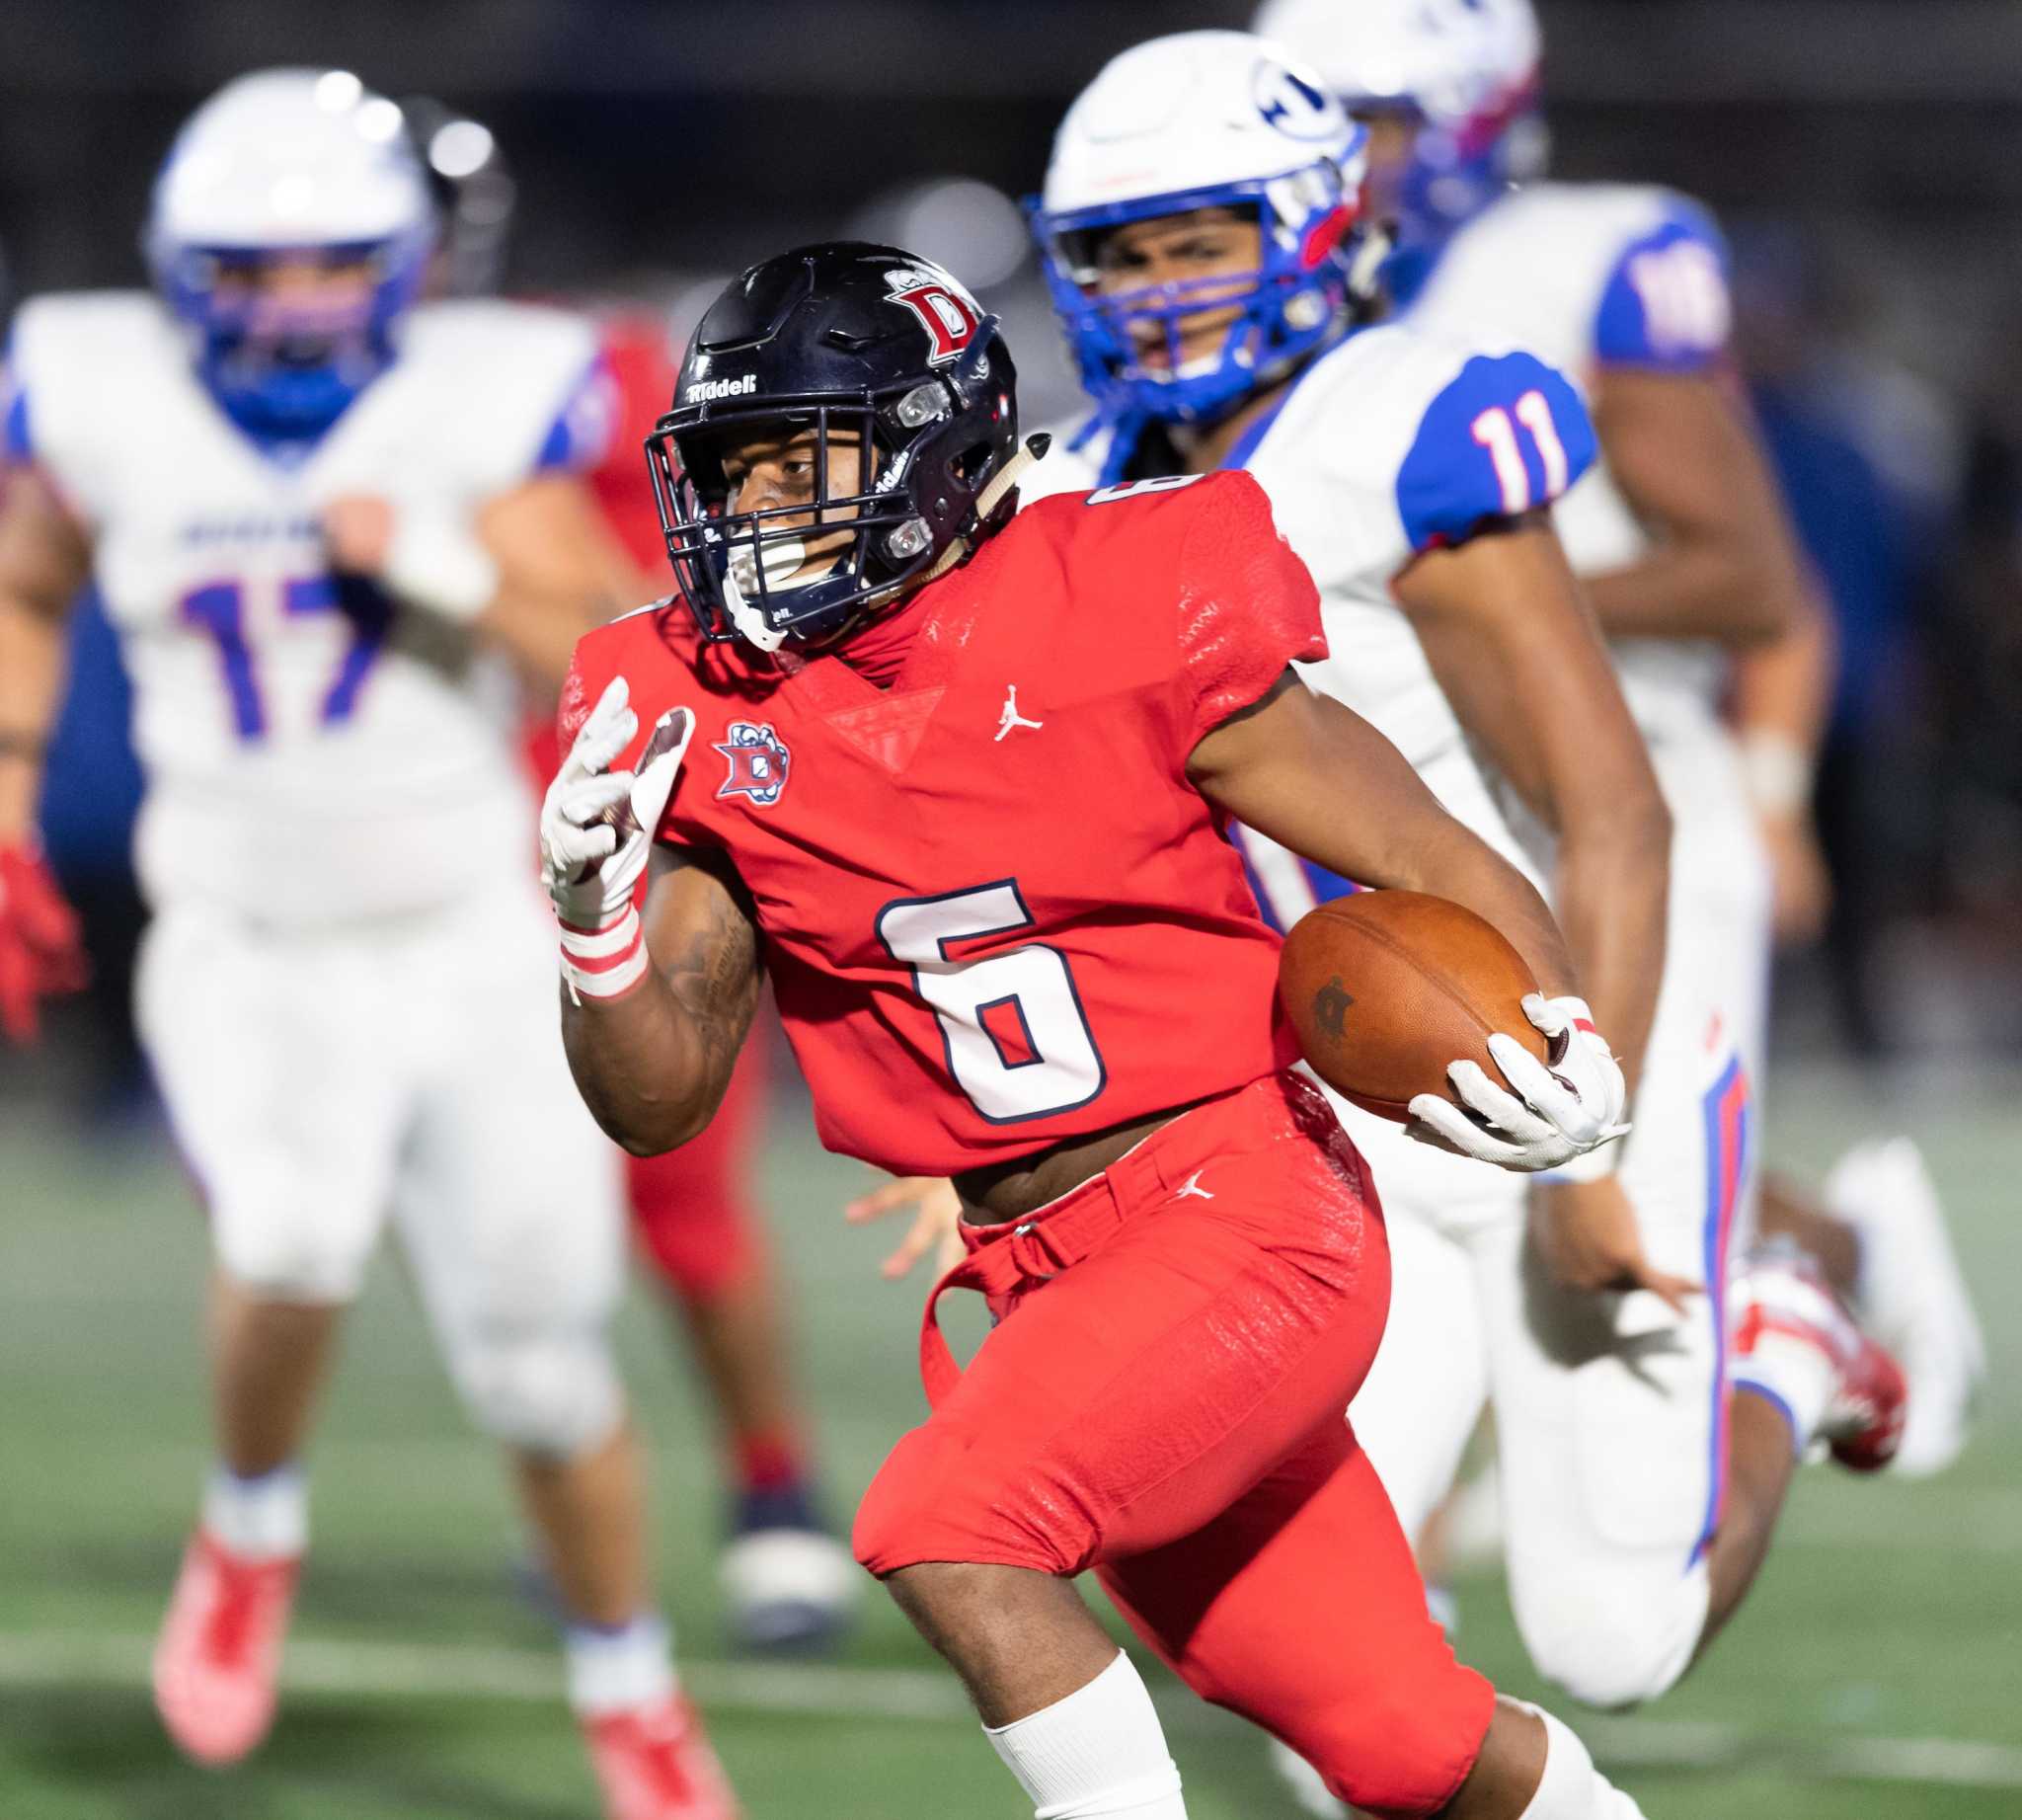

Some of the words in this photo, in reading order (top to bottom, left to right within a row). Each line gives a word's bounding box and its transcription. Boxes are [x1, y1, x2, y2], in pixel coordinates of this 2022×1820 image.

[686, 374, 757, 403] Riddell
[1469, 389, 1568, 514] 11
[874, 877, 1107, 1125] 6
